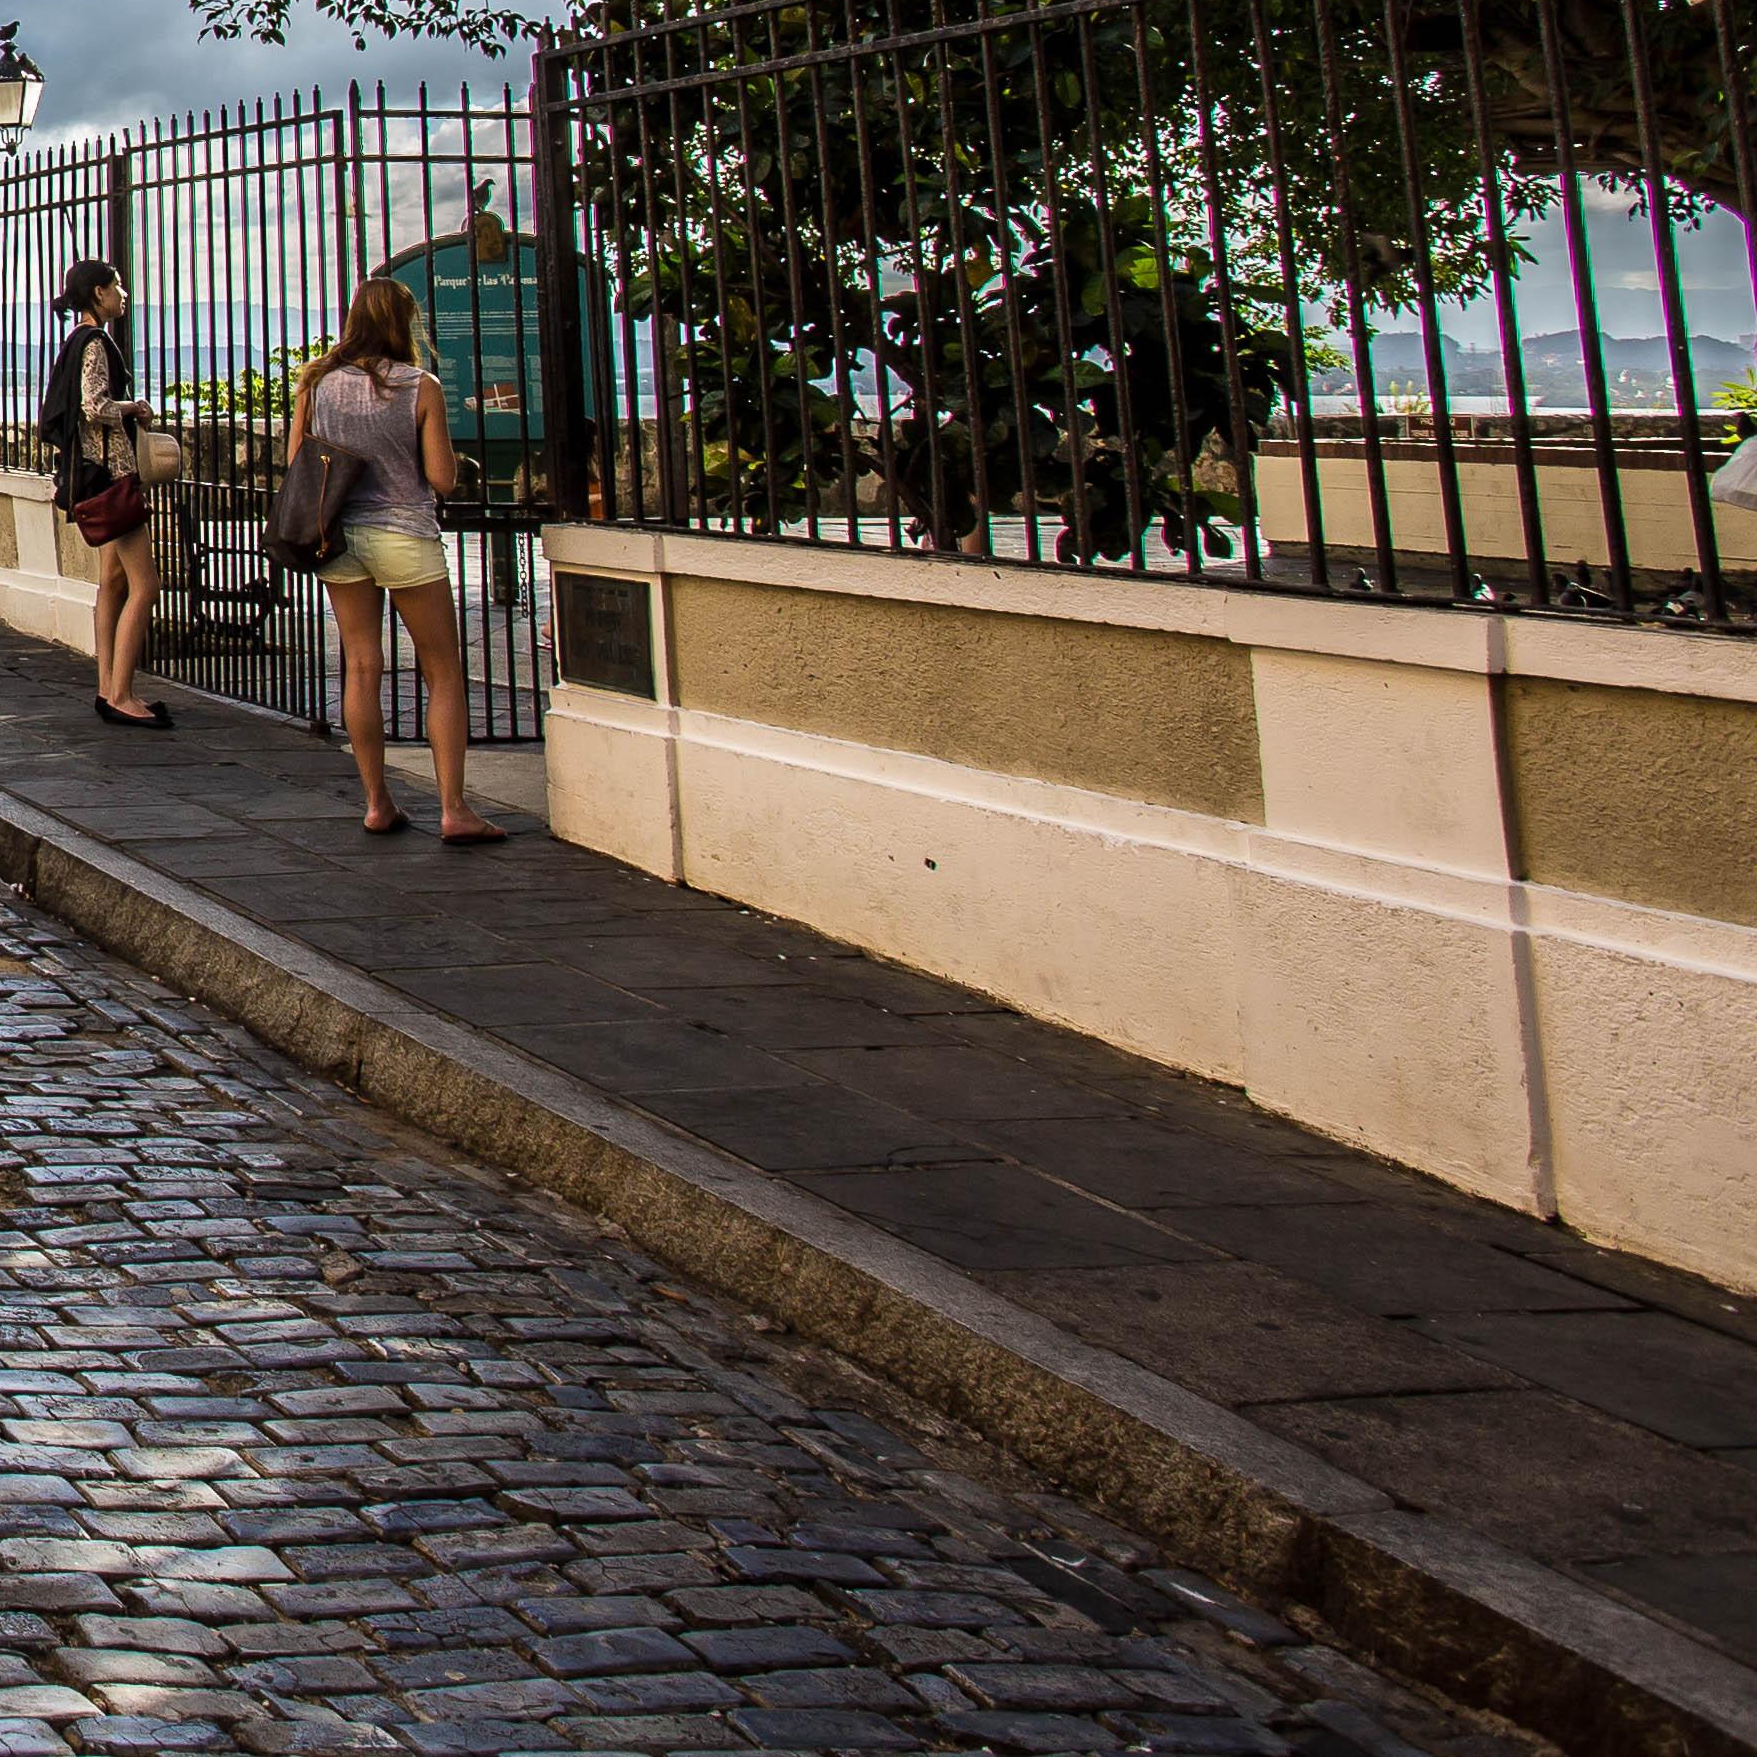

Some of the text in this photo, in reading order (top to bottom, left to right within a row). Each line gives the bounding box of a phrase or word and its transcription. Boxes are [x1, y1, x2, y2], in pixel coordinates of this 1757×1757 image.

[434, 274, 467, 289] Parque
[483, 274, 498, 286] las
[498, 273, 538, 286] Paoma
